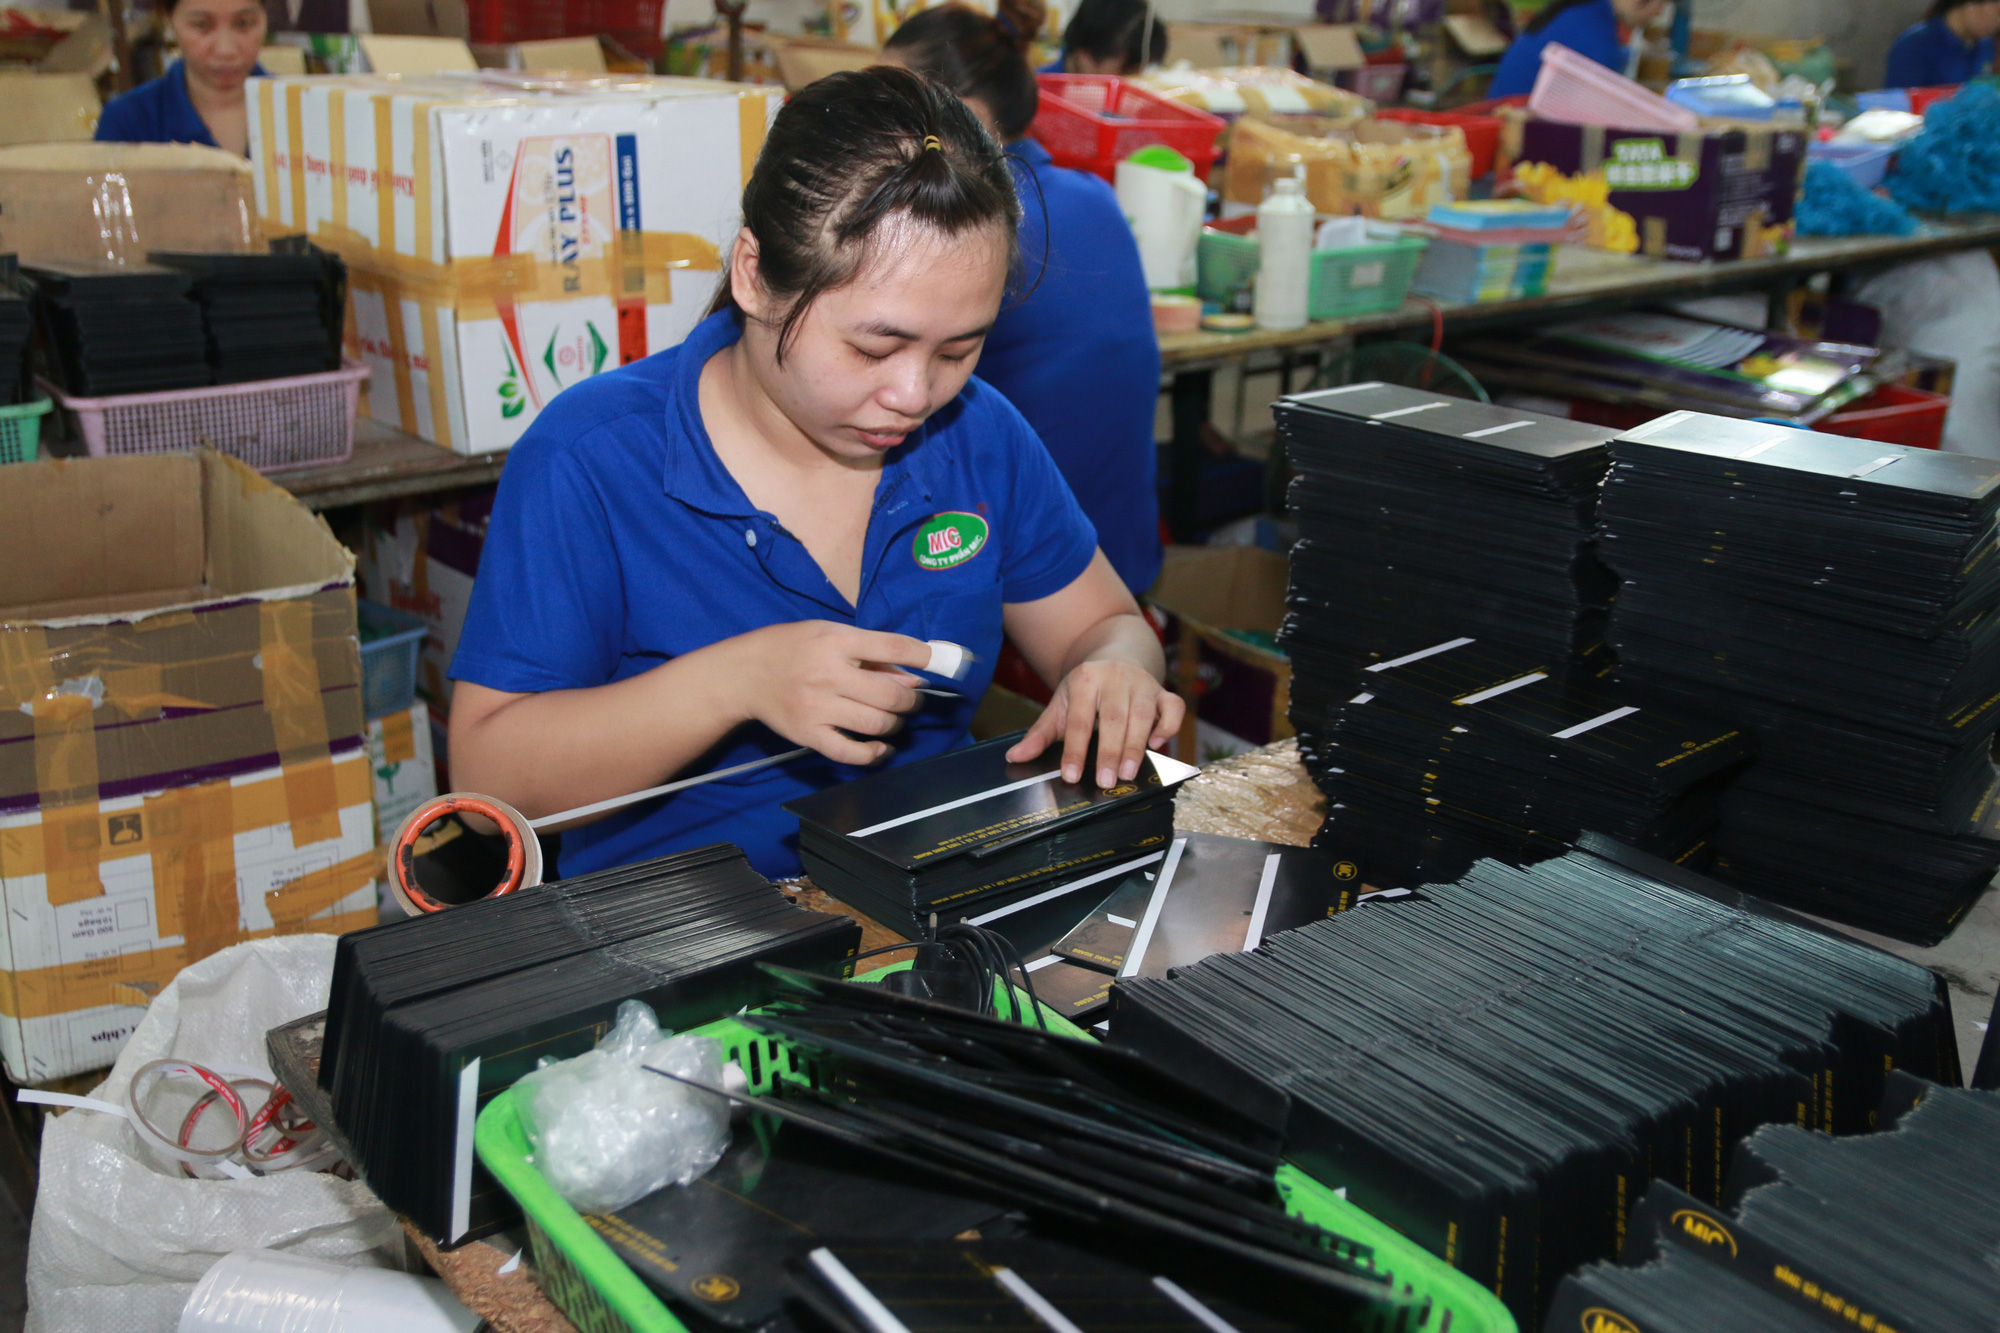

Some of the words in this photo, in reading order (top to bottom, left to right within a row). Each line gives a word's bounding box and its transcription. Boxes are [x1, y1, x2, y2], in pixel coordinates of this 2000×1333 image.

[555, 147, 578, 223] PLUS
[561, 233, 581, 293] RAY
[927, 526, 962, 555] MIC
[1338, 864, 1353, 878] MIC
[91, 1025, 127, 1044] chips
[1683, 1215, 1725, 1244] MIC
[1592, 1315, 1634, 1333] MI
